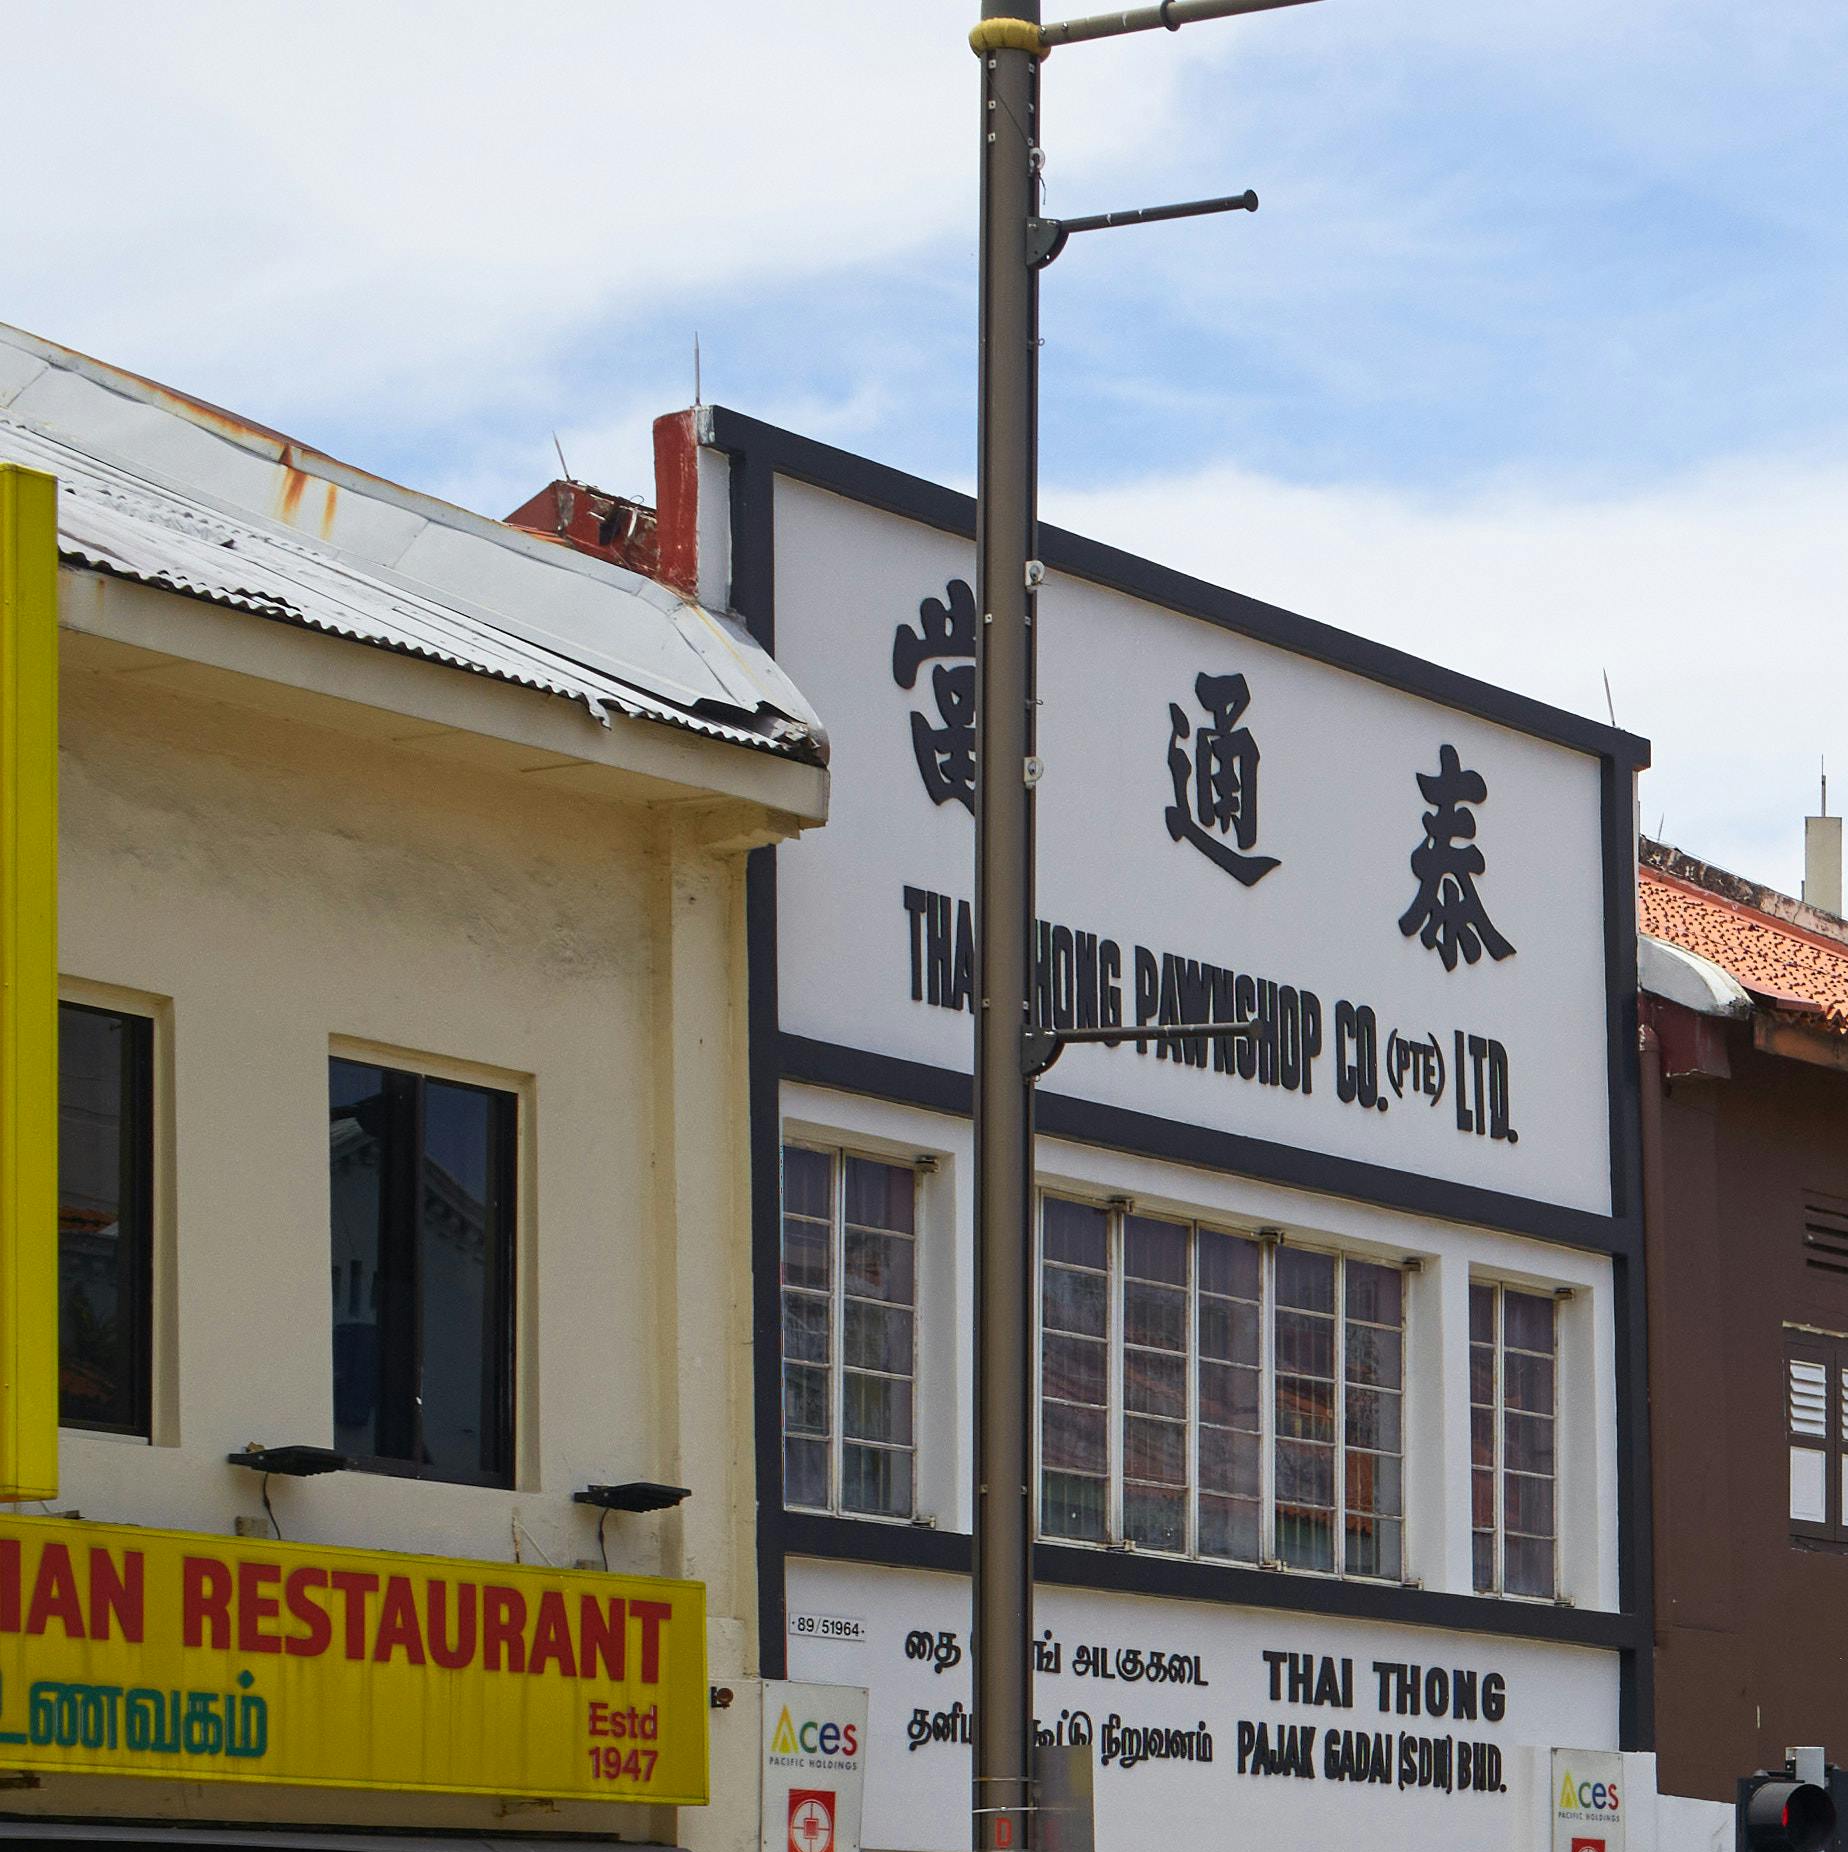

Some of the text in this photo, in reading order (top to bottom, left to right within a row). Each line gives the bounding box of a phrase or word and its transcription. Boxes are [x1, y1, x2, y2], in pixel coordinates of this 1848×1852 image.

[904, 885, 1519, 1144] THA HONG PAWNSHOP CO. (PTE) LTD.
[183, 1556, 672, 1684] RESTAURANT
[1263, 1650, 1506, 1722] THAI THONG
[589, 1703, 658, 1740] Estd
[770, 1704, 858, 1756] Aces
[588, 1747, 659, 1782] 1947
[769, 1756, 858, 1772] PACIFIC HOLDINGS
[1237, 1720, 1507, 1794] PAJAK GADAI (SDN) BHD.
[1559, 1769, 1620, 1810] Aces
[1558, 1810, 1621, 1823] PACIFIC HOLDINGS
